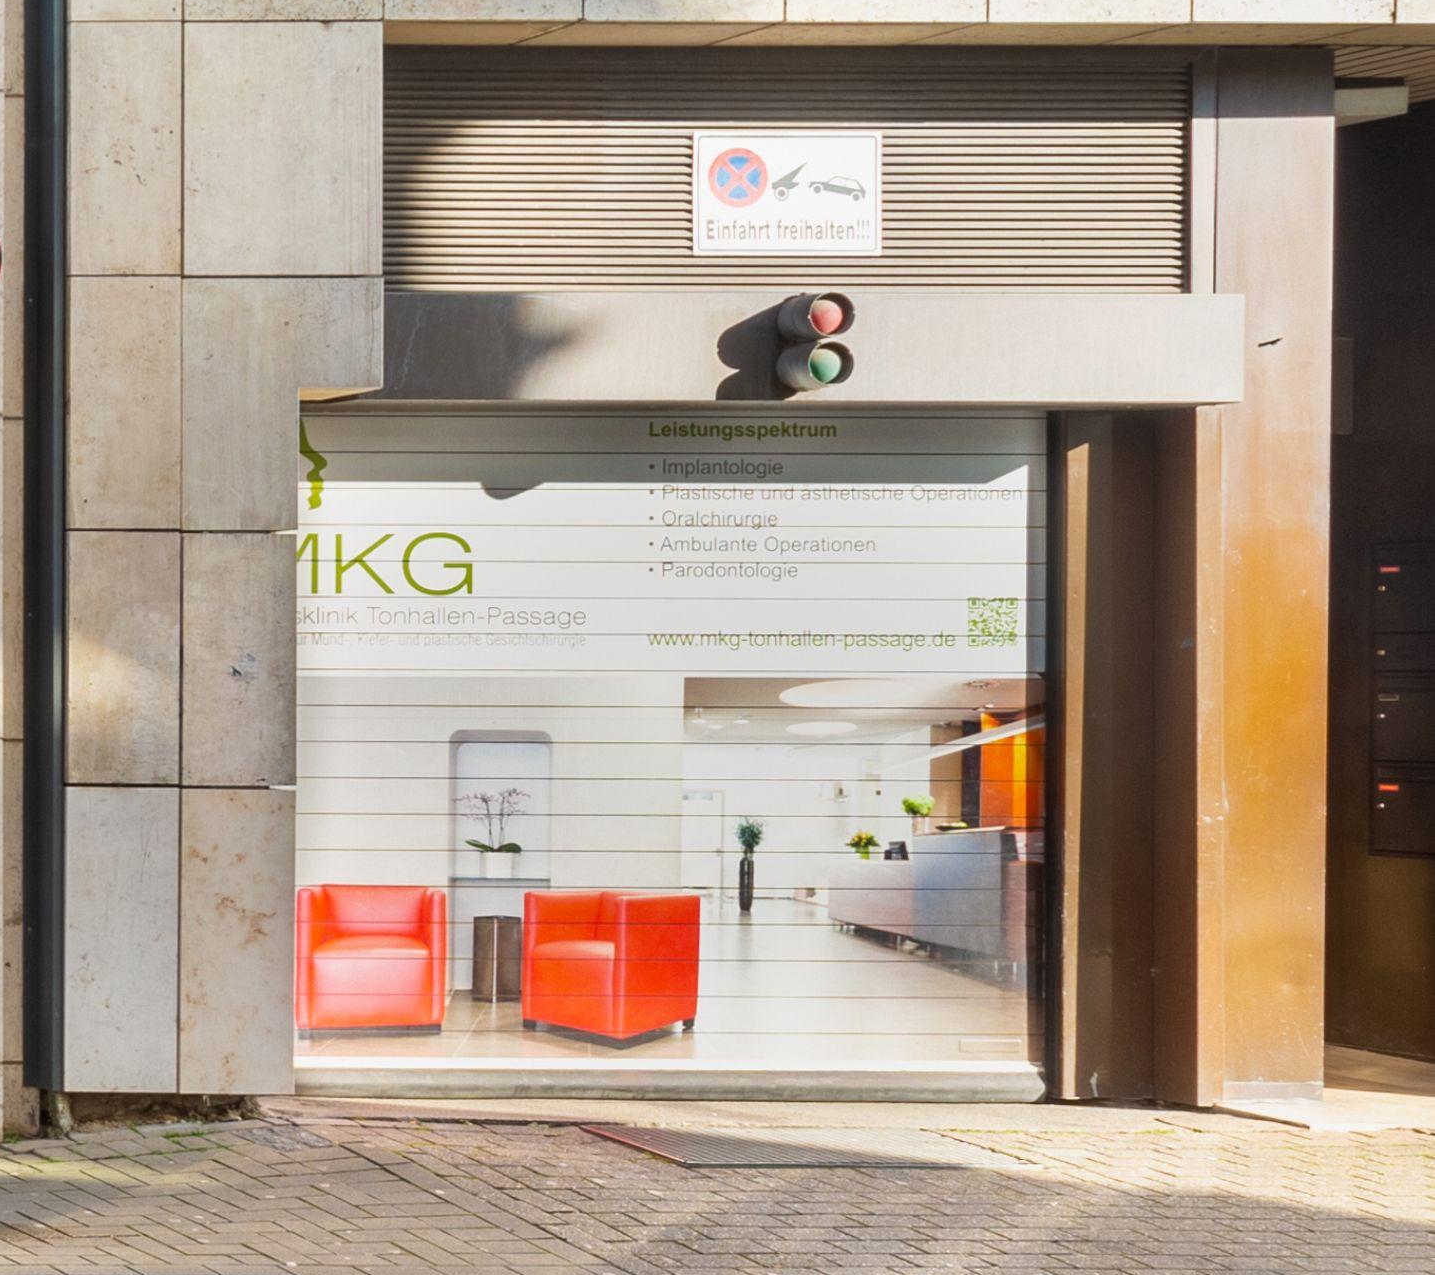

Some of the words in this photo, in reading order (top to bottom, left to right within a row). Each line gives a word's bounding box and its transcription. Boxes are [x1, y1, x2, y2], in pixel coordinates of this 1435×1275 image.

[706, 219, 771, 240] Einfahrt
[777, 219, 870, 240] freihalten!!!
[648, 421, 838, 441] Leistungsspektrum
[660, 457, 785, 478] Implantologie
[660, 484, 756, 503] Plastische
[760, 484, 795, 503] und
[799, 484, 906, 503] ästhetische
[910, 484, 1026, 506] Operationen
[660, 509, 780, 531] Oralchirurgie
[658, 536, 759, 554] Ambulante
[763, 536, 878, 555] Operationen
[296, 531, 473, 596] KG
[660, 562, 800, 582] Parodontologie
[367, 606, 587, 629] Tonhallen-Passage
[648, 630, 957, 652] www.mkg-tonhallen-passage.de
